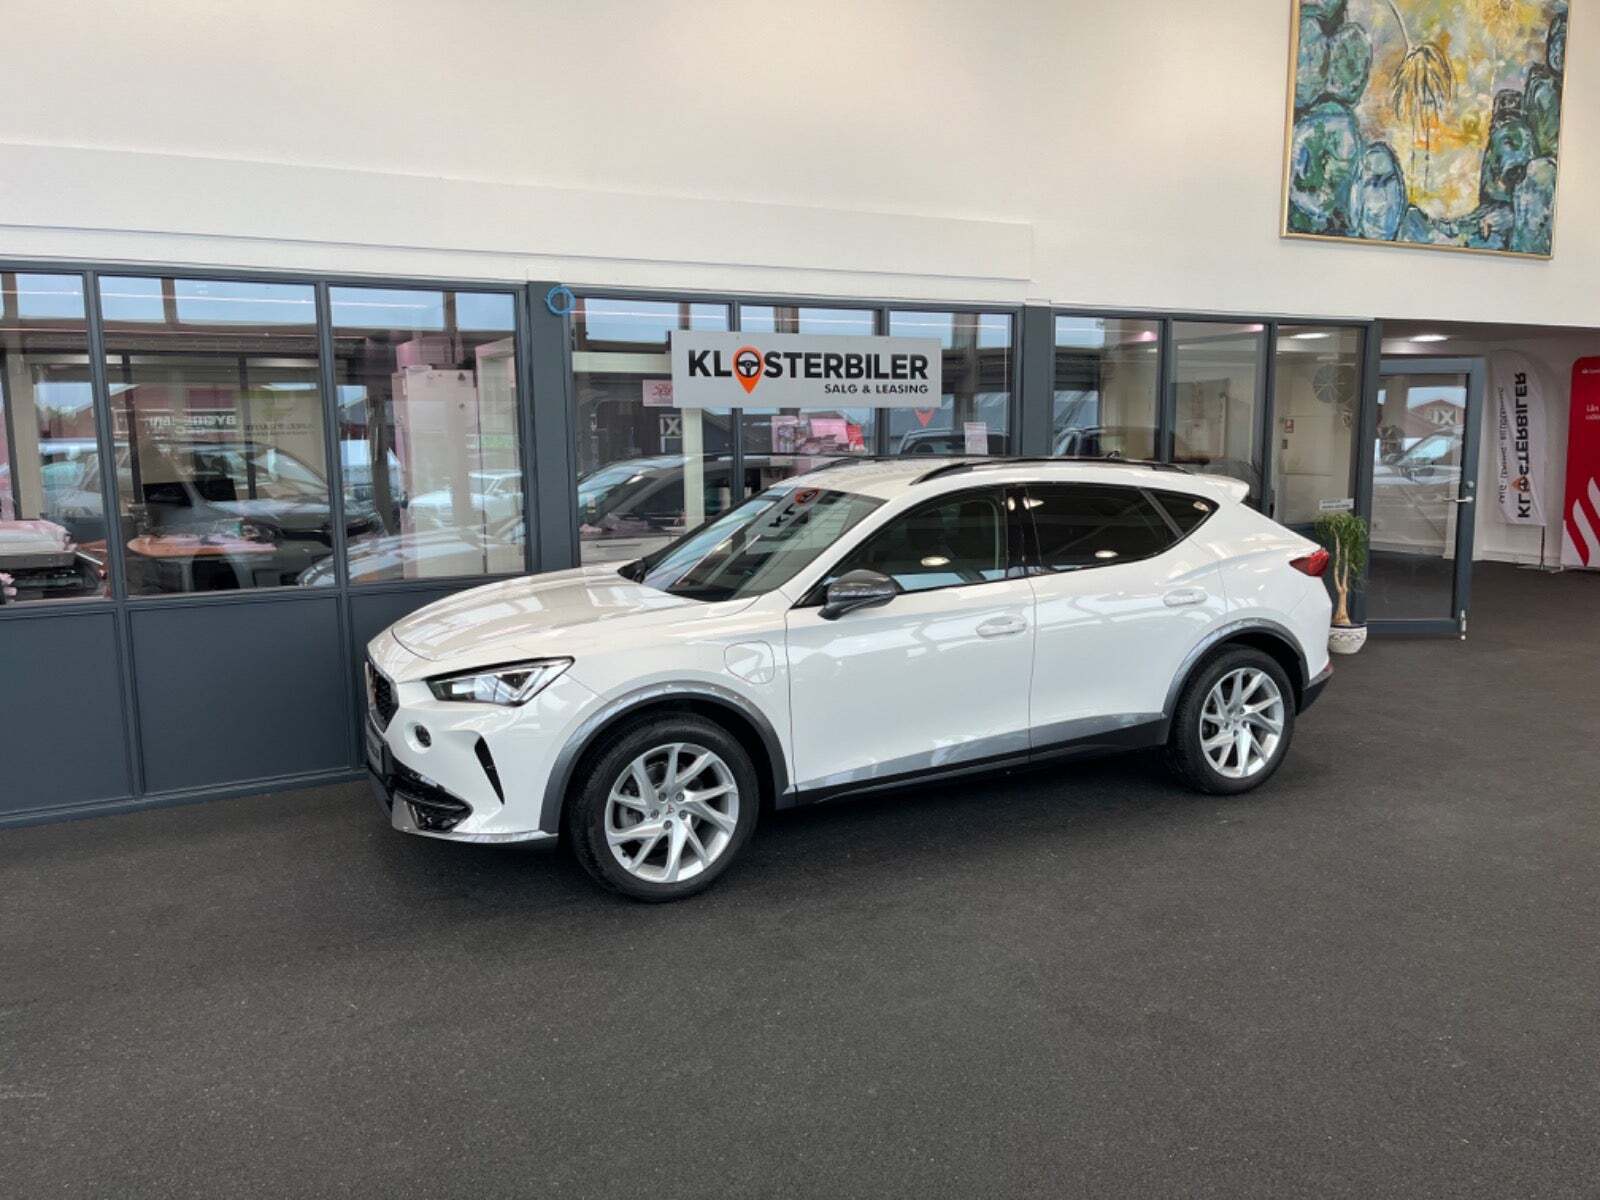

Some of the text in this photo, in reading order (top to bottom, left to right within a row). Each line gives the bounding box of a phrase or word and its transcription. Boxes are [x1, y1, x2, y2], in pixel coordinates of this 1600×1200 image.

[688, 349, 929, 380] KLOSTERBILER
[824, 383, 929, 394] SALG & LEASING
